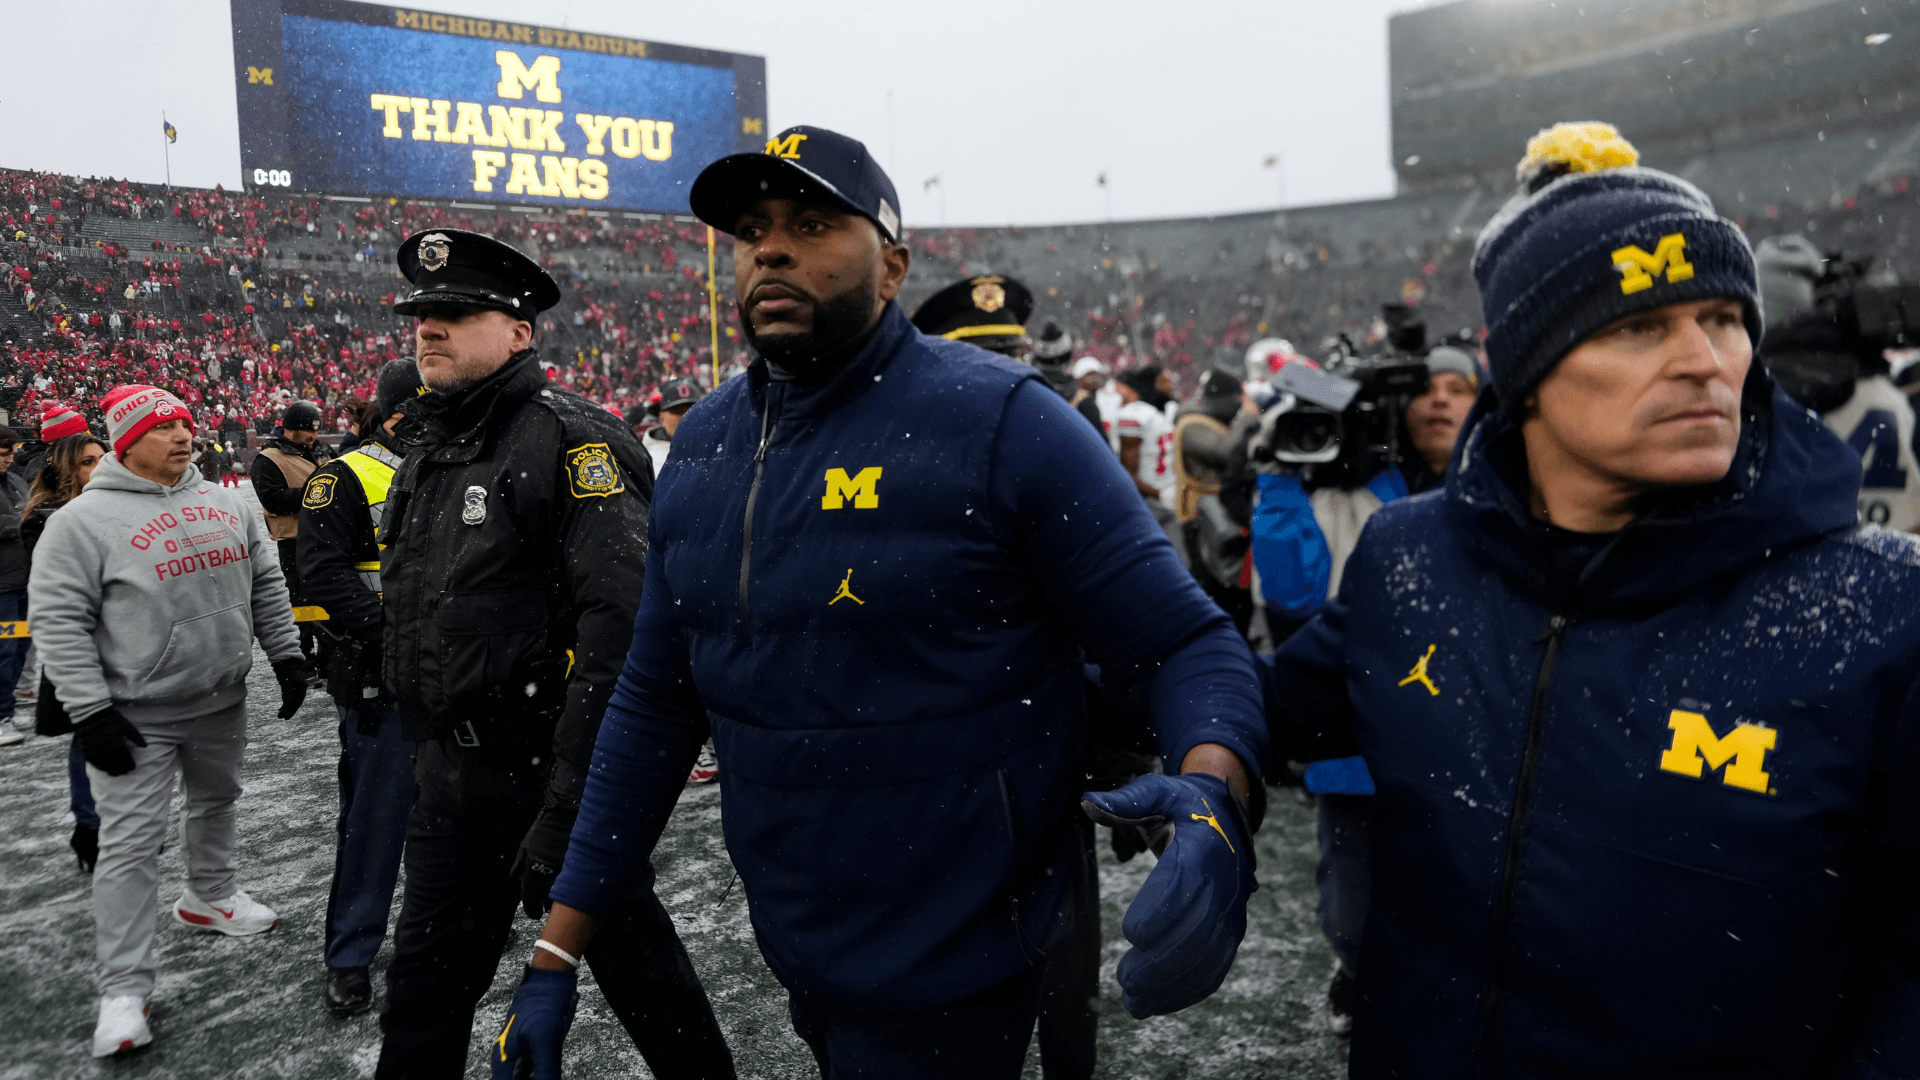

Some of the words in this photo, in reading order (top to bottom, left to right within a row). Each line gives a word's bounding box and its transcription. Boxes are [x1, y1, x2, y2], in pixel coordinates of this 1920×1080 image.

[396, 10, 533, 43] MICHIGAN
[538, 28, 647, 57] STADIUM
[247, 66, 274, 85] M
[495, 50, 562, 103] M
[371, 93, 565, 152] THANK
[576, 113, 674, 161] YOU
[765, 133, 808, 159] M
[254, 168, 292, 187] 0:00
[472, 150, 609, 200] FANS
[1611, 233, 1694, 295] M
[113, 395, 149, 423] OHIO
[572, 448, 609, 466] POLICE
[822, 466, 883, 510] M
[130, 512, 178, 551] OHIO
[181, 506, 239, 531] STATE
[155, 543, 249, 582] FOOTBALL
[1660, 709, 1777, 794] M
